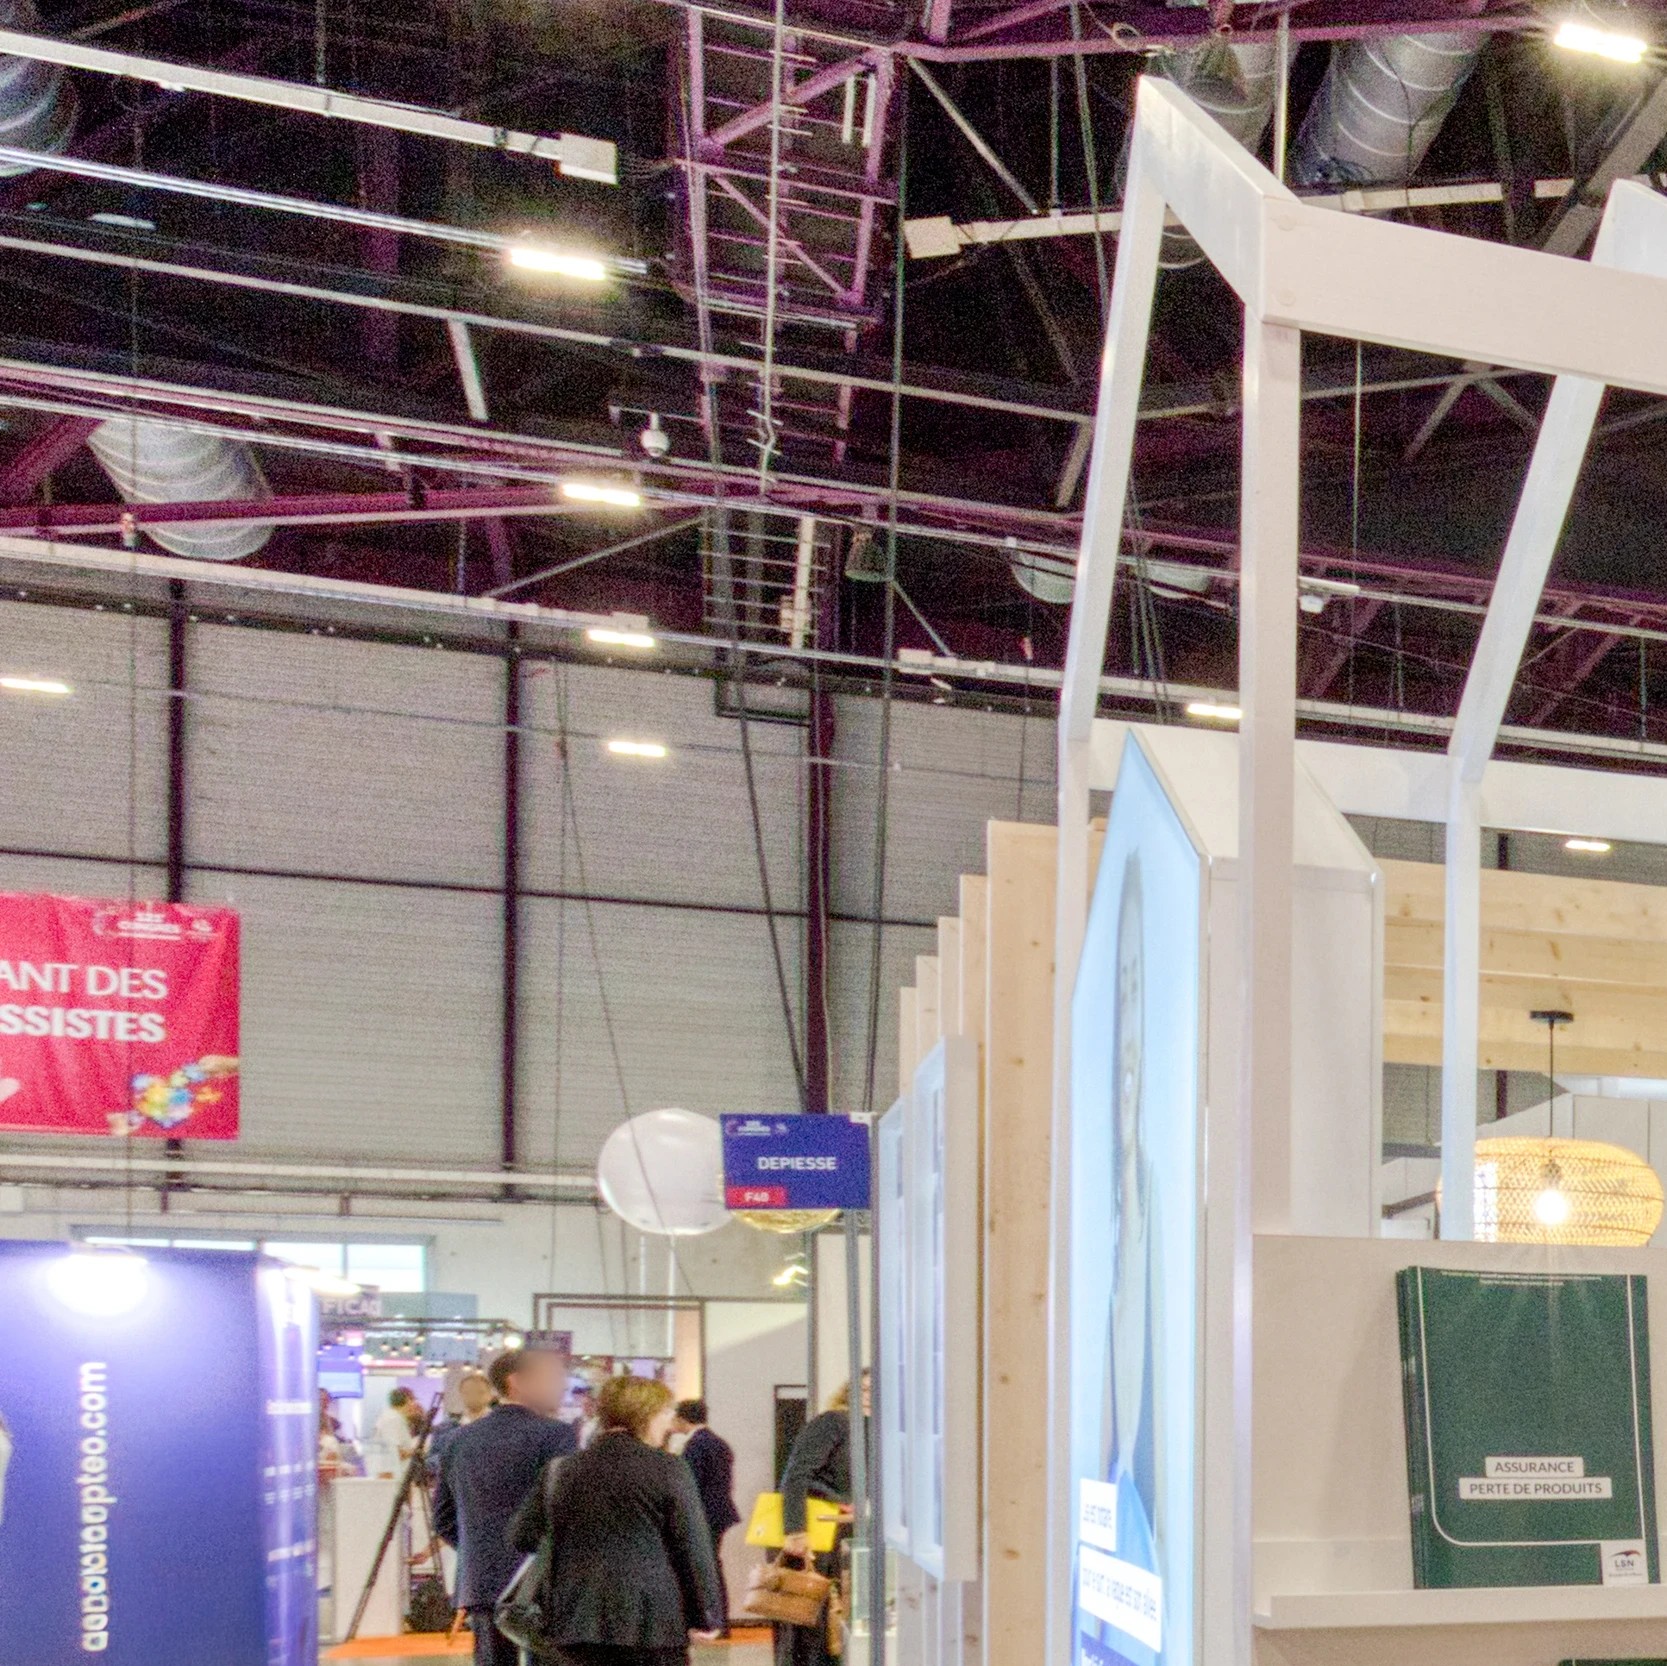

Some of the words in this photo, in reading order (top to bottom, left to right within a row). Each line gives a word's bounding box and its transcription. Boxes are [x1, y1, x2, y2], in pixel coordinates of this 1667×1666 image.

[87, 965, 168, 1000] DES
[757, 1156, 837, 1171] DEPIESSE
[1494, 1461, 1575, 1473] ASSURANCE
[1470, 1483, 1510, 1495] PERTE
[1513, 1483, 1530, 1494] DE
[1534, 1482, 1602, 1494] PRODUITS
[1614, 1559, 1634, 1568] LSN
